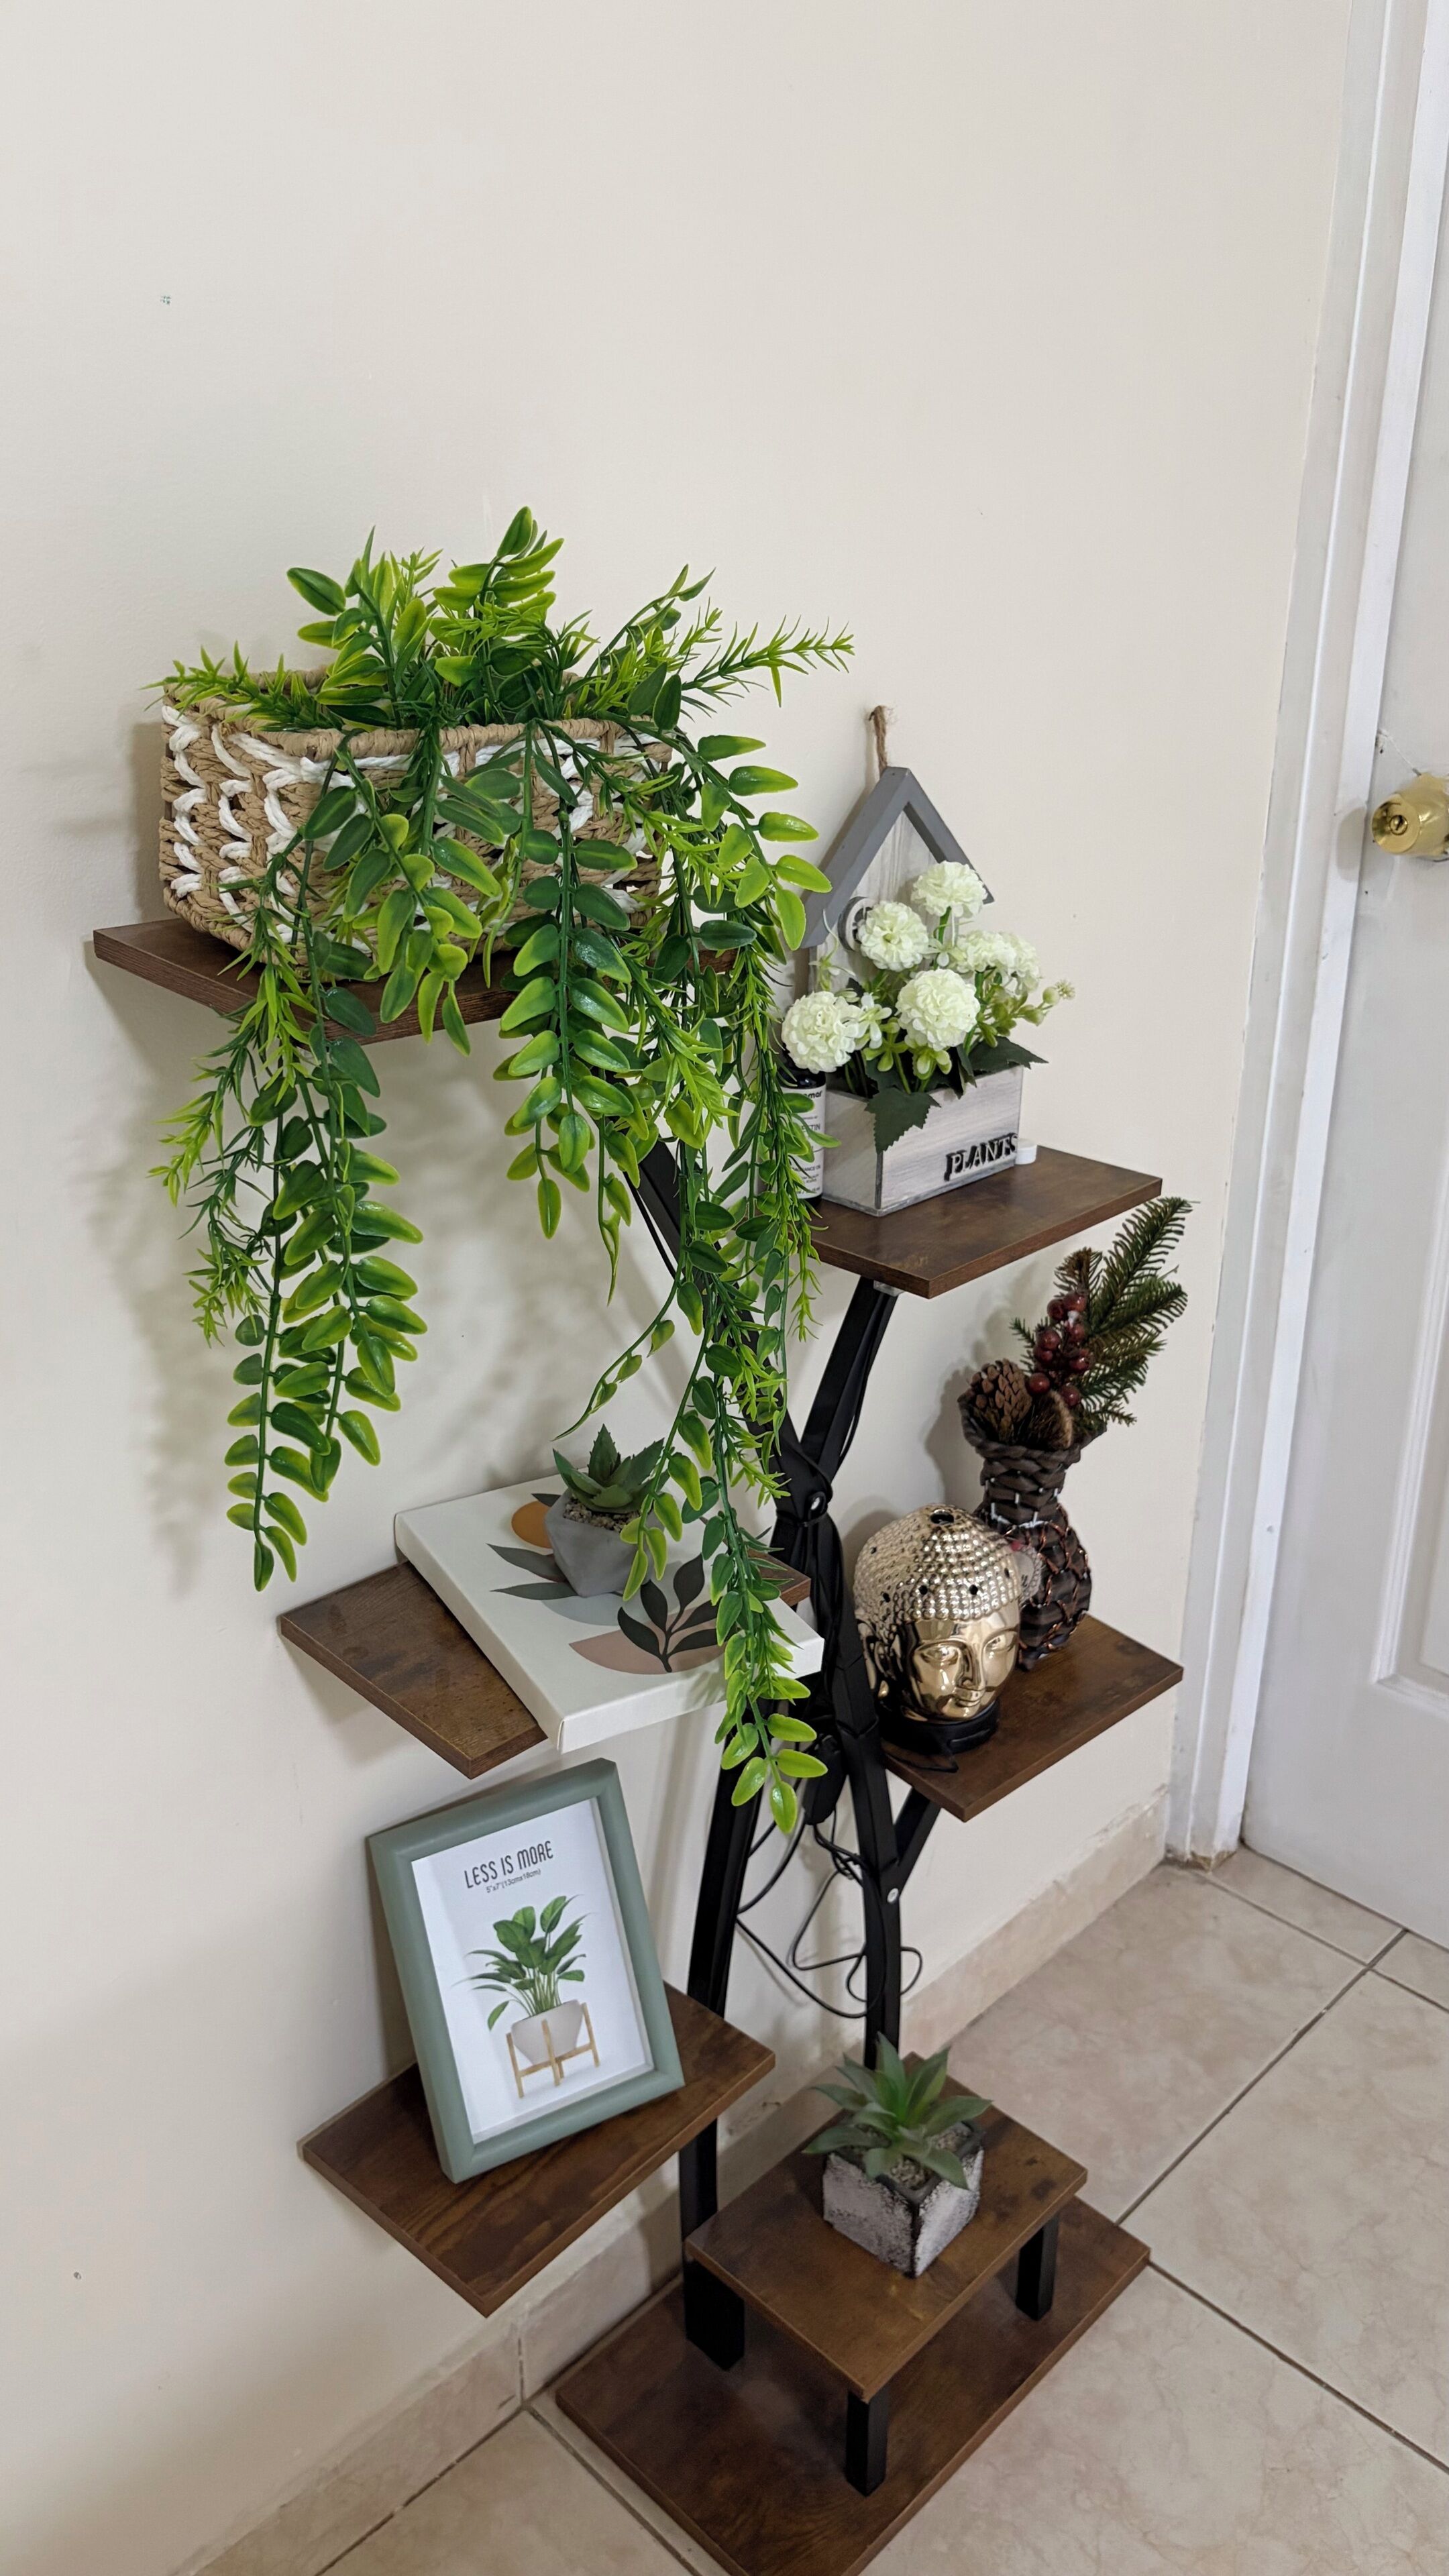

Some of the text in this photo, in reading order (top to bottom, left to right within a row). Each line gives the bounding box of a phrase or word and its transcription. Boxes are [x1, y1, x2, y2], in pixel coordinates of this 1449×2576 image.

[943, 1132, 1018, 1182] PLANTS
[464, 1840, 553, 1888] LESS IS MORE
